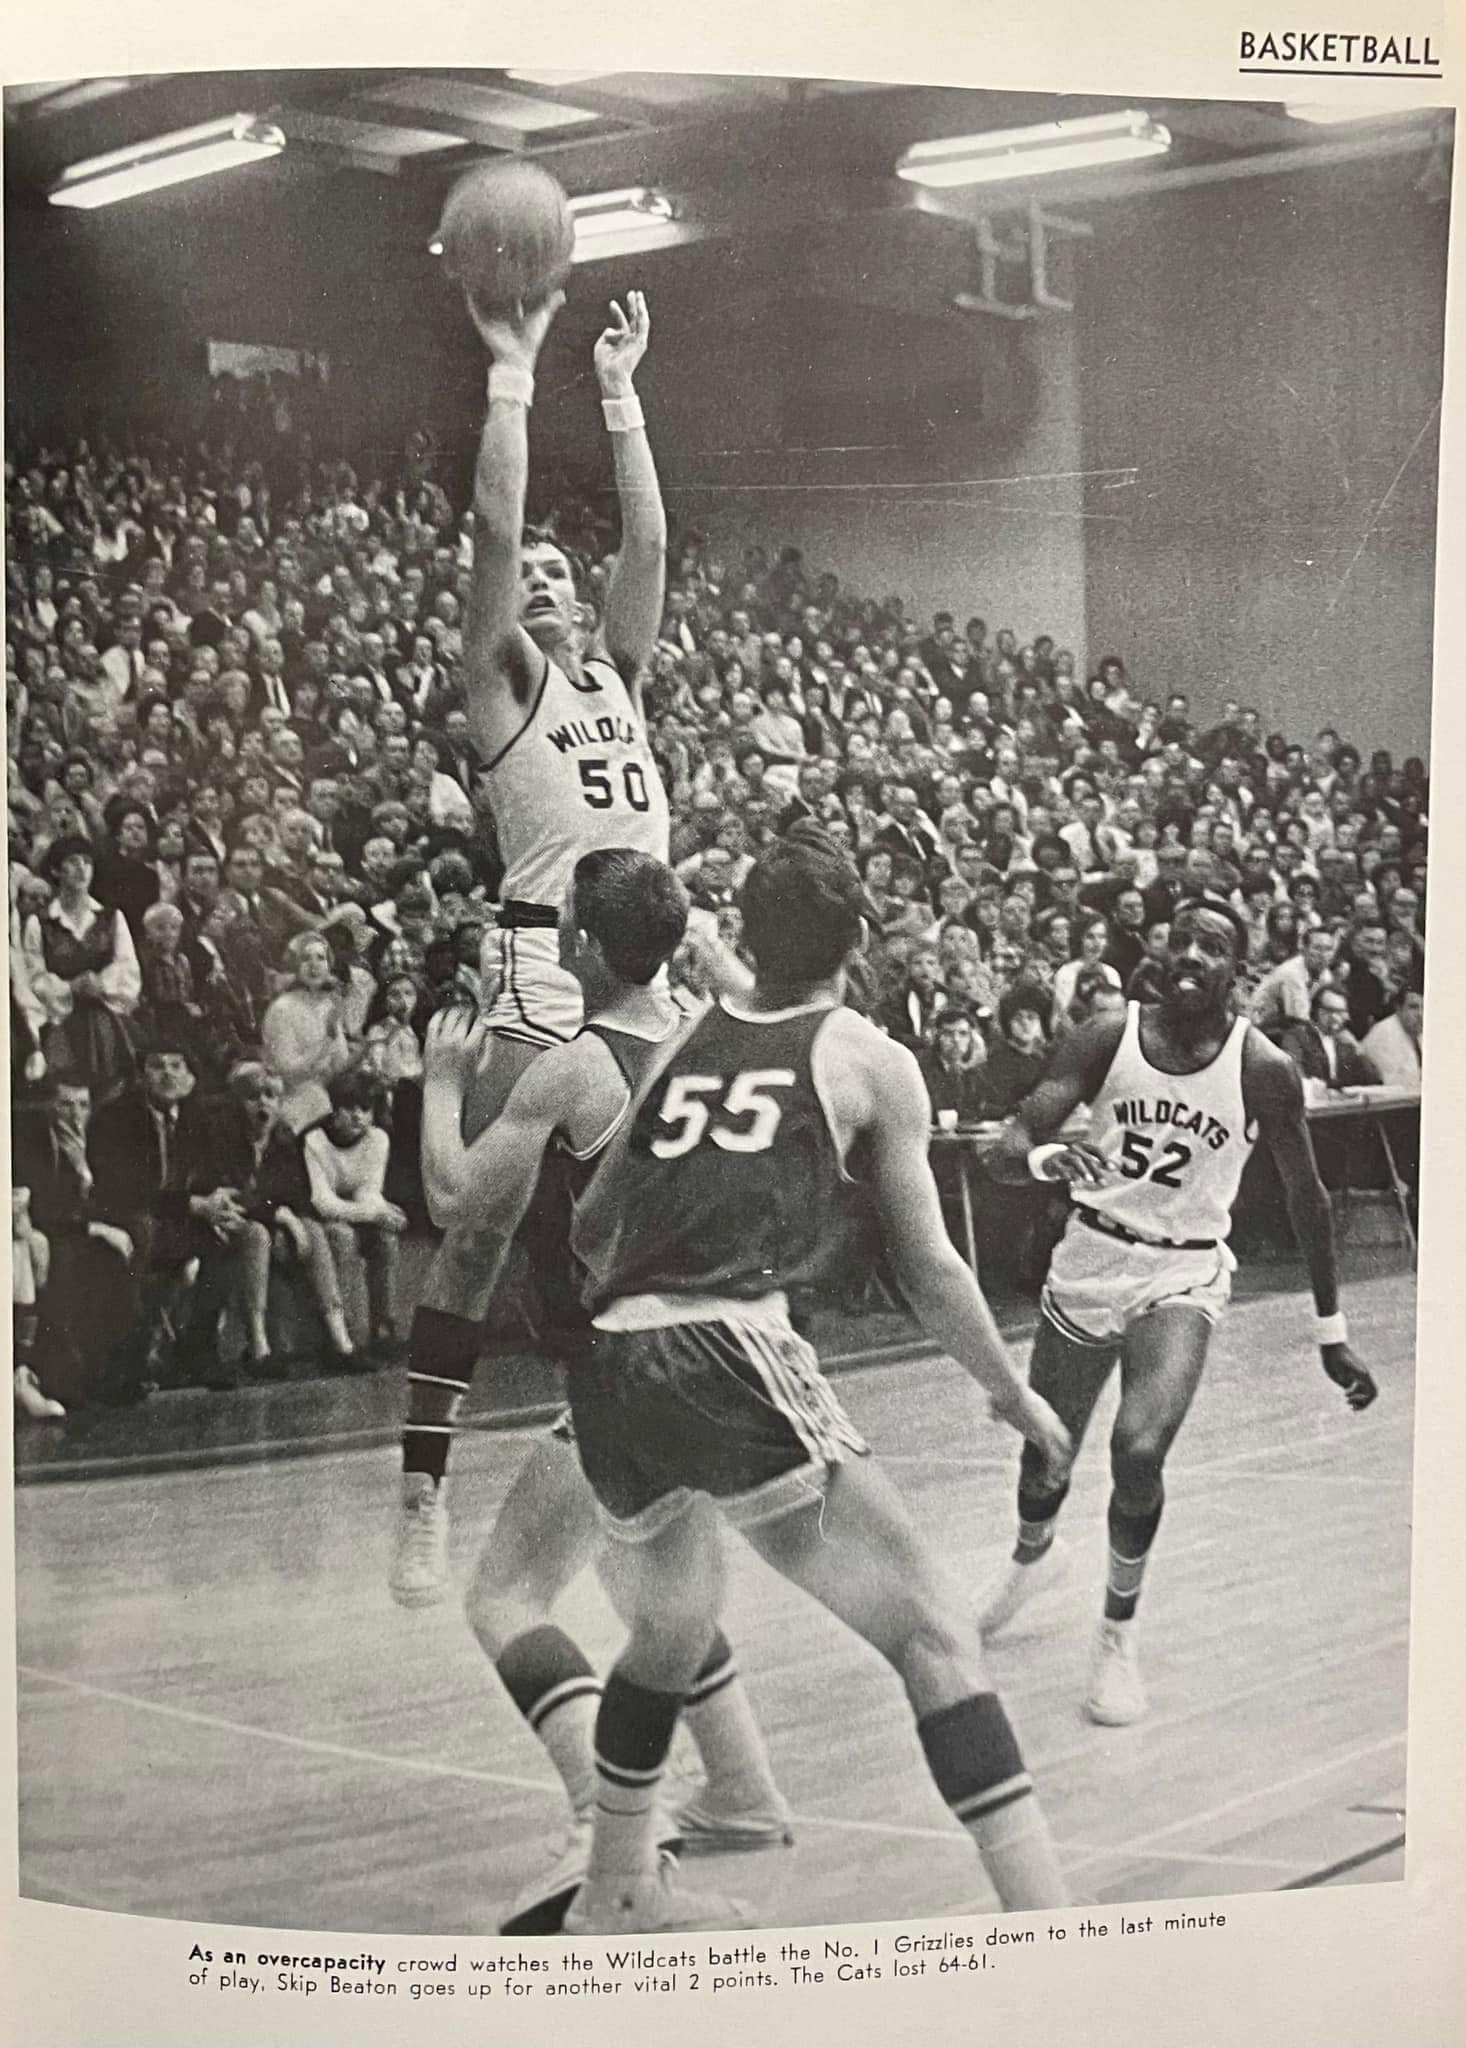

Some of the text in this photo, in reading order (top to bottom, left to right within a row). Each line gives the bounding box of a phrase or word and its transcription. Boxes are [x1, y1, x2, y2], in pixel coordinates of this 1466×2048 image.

[1240, 31, 1440, 65] BASKETBALL
[578, 760, 649, 812] 50
[651, 1069, 796, 1159] 55
[1113, 1099, 1229, 1150] WILDCATS
[1120, 1130, 1192, 1188] 52
[188, 1943, 214, 1962] As
[223, 1951, 247, 1965] an
[257, 1953, 387, 1976] overcapacity
[396, 1953, 457, 1973] crowd
[469, 1951, 550, 1973] watches
[561, 1951, 594, 1972] the
[605, 1948, 697, 1971] Wildcats
[708, 1944, 767, 1966] battle
[778, 1942, 811, 1962] the
[824, 1940, 860, 1960] No.
[894, 1931, 975, 1954] Grizzlies
[985, 1927, 1035, 1947] down
[1047, 1925, 1067, 1941] to
[1078, 1919, 1109, 1938] the
[1120, 1916, 1154, 1936] last
[1164, 1911, 1227, 1931] minute
[187, 1967, 209, 1986] of
[276, 1971, 318, 1997] Skip
[330, 1975, 397, 1996] Beaton
[409, 1983, 456, 2001] goes
[467, 1983, 492, 2001] up
[503, 1976, 534, 1996] for
[545, 1975, 623, 1996] another
[633, 1972, 677, 1993] vital
[688, 1972, 700, 1991] 2
[712, 1969, 779, 1993] points.
[789, 1964, 825, 1985] The
[836, 1962, 882, 1982] Cats
[893, 1958, 928, 1977] lost
[938, 1952, 996, 1974] 64-61.
